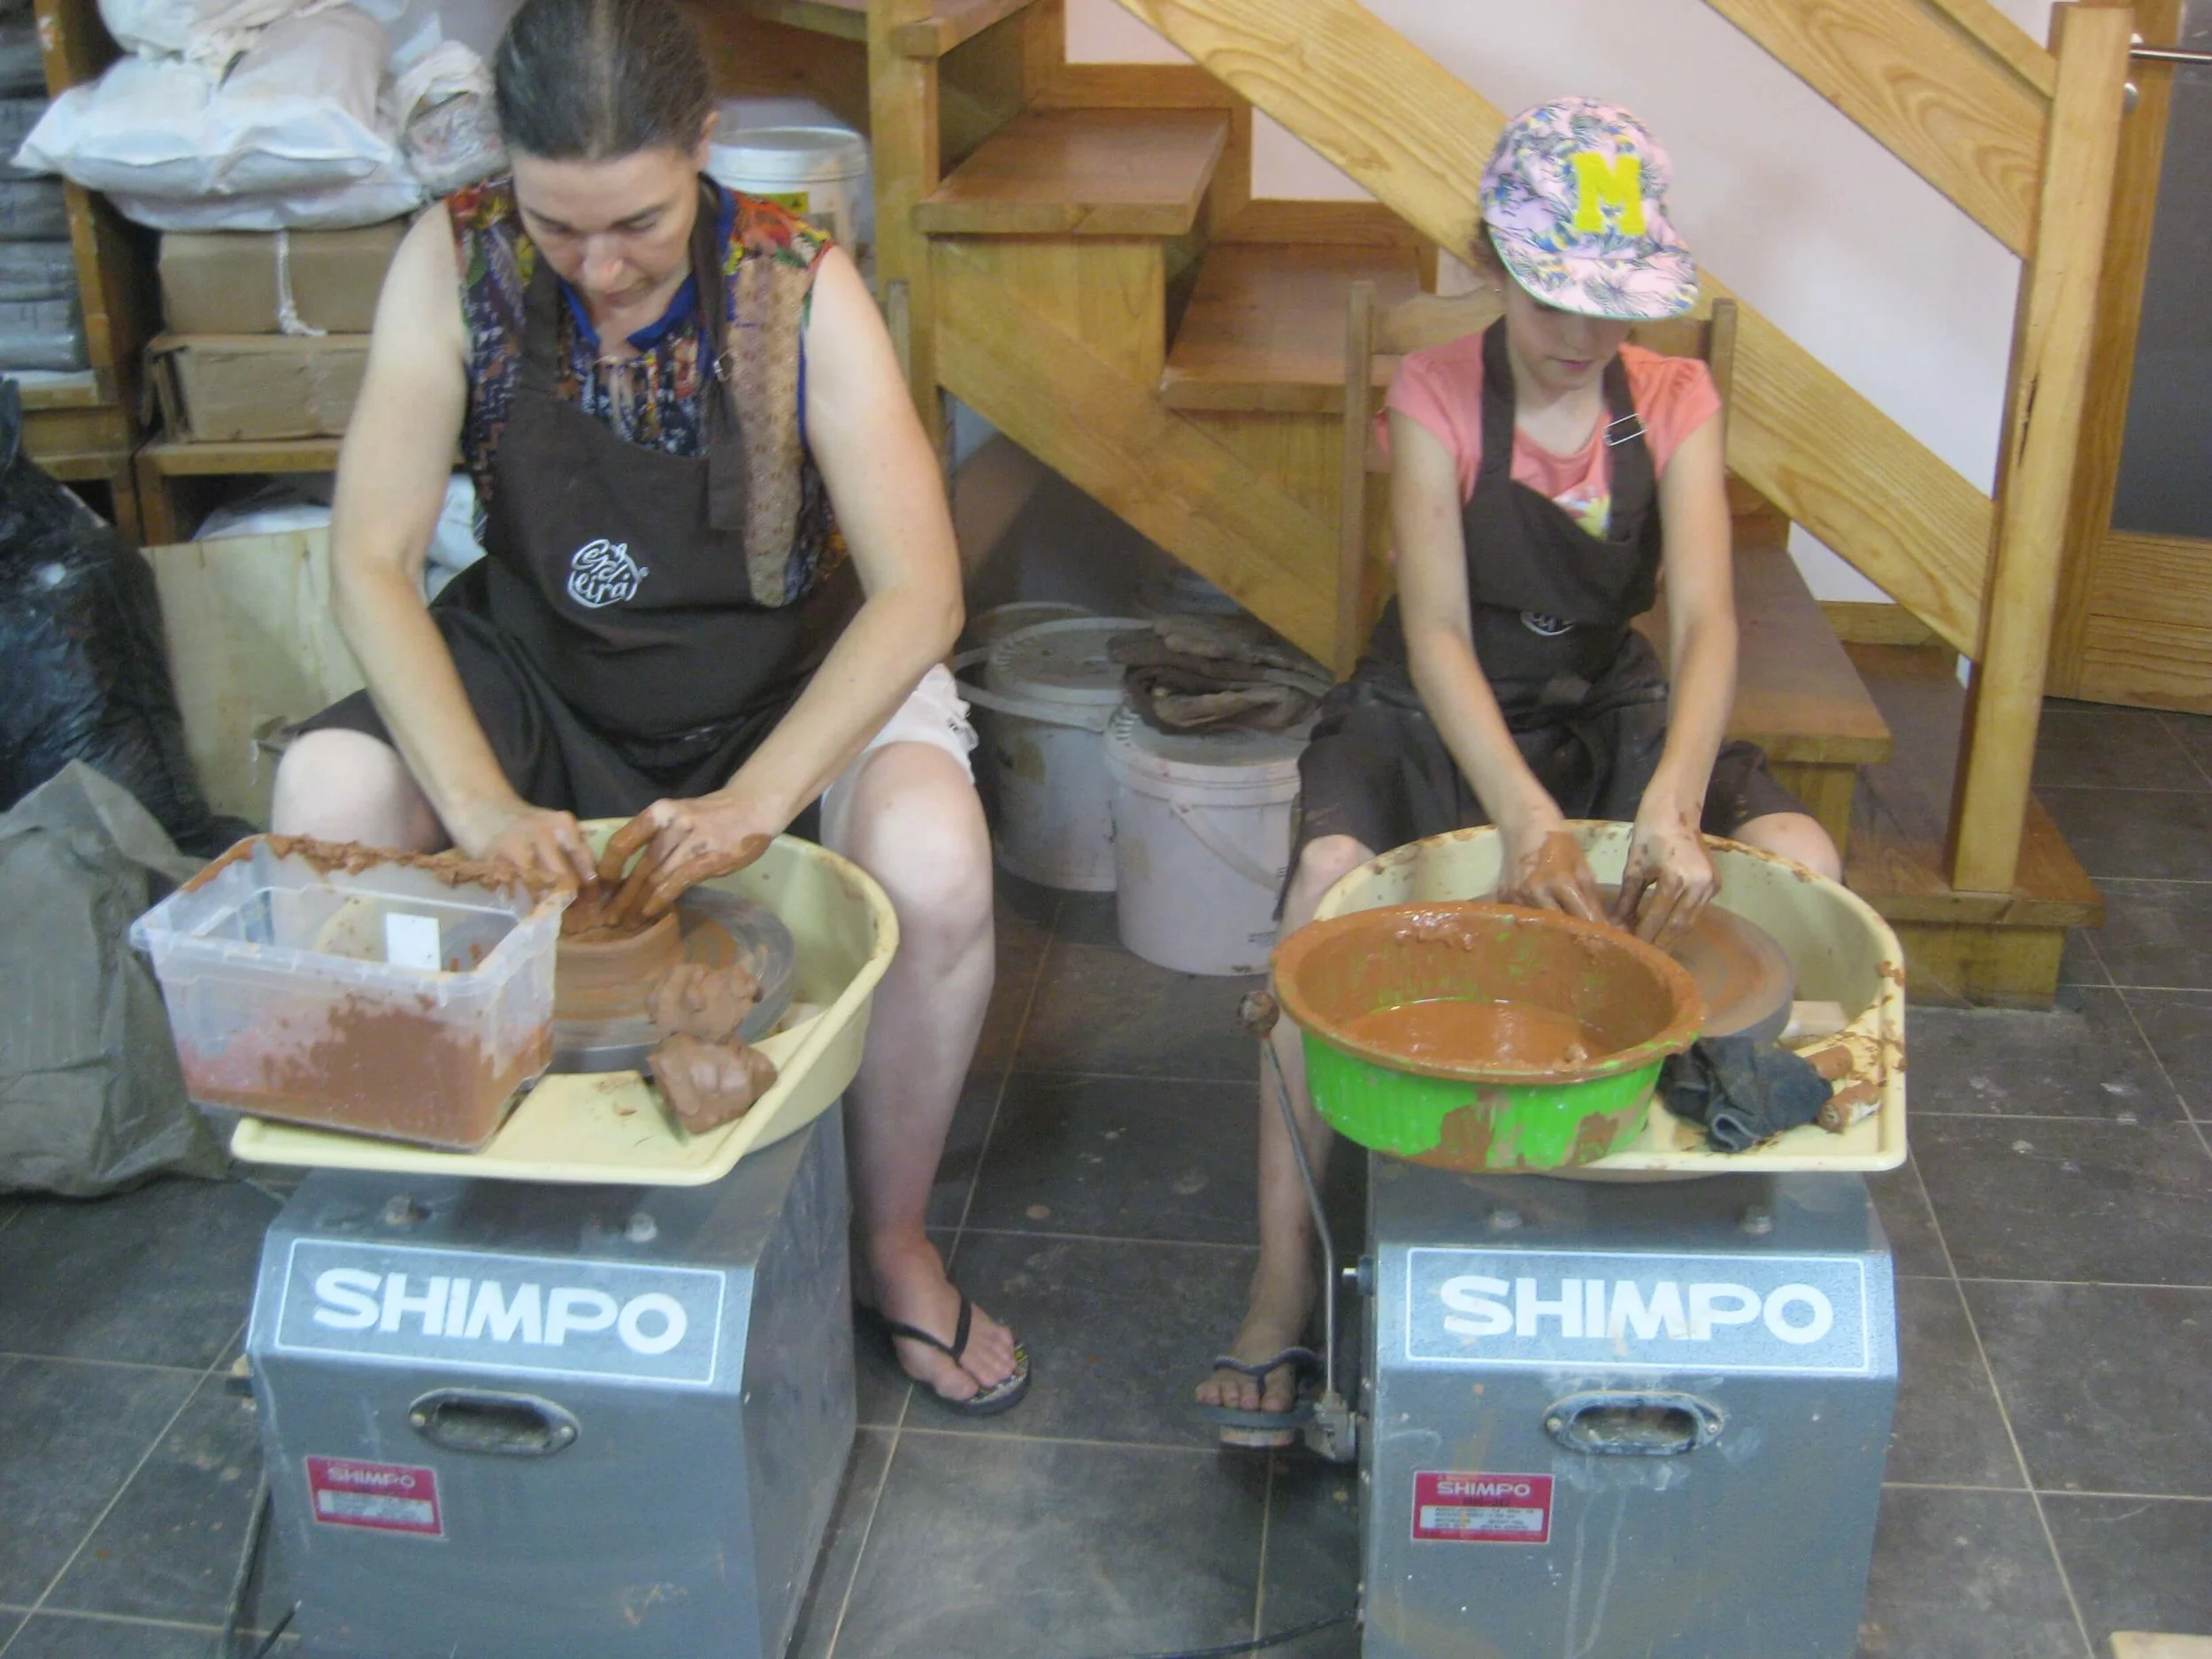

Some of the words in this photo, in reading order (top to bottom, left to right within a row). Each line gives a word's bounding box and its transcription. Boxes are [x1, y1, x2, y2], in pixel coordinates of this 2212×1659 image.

[1571, 152, 1647, 235] M
[313, 1268, 687, 1355] SHIMPO
[1440, 1276, 1834, 1344] SHIMPO
[328, 1466, 416, 1489] SHIMPO
[1437, 1481, 1531, 1497] SHIMPO
